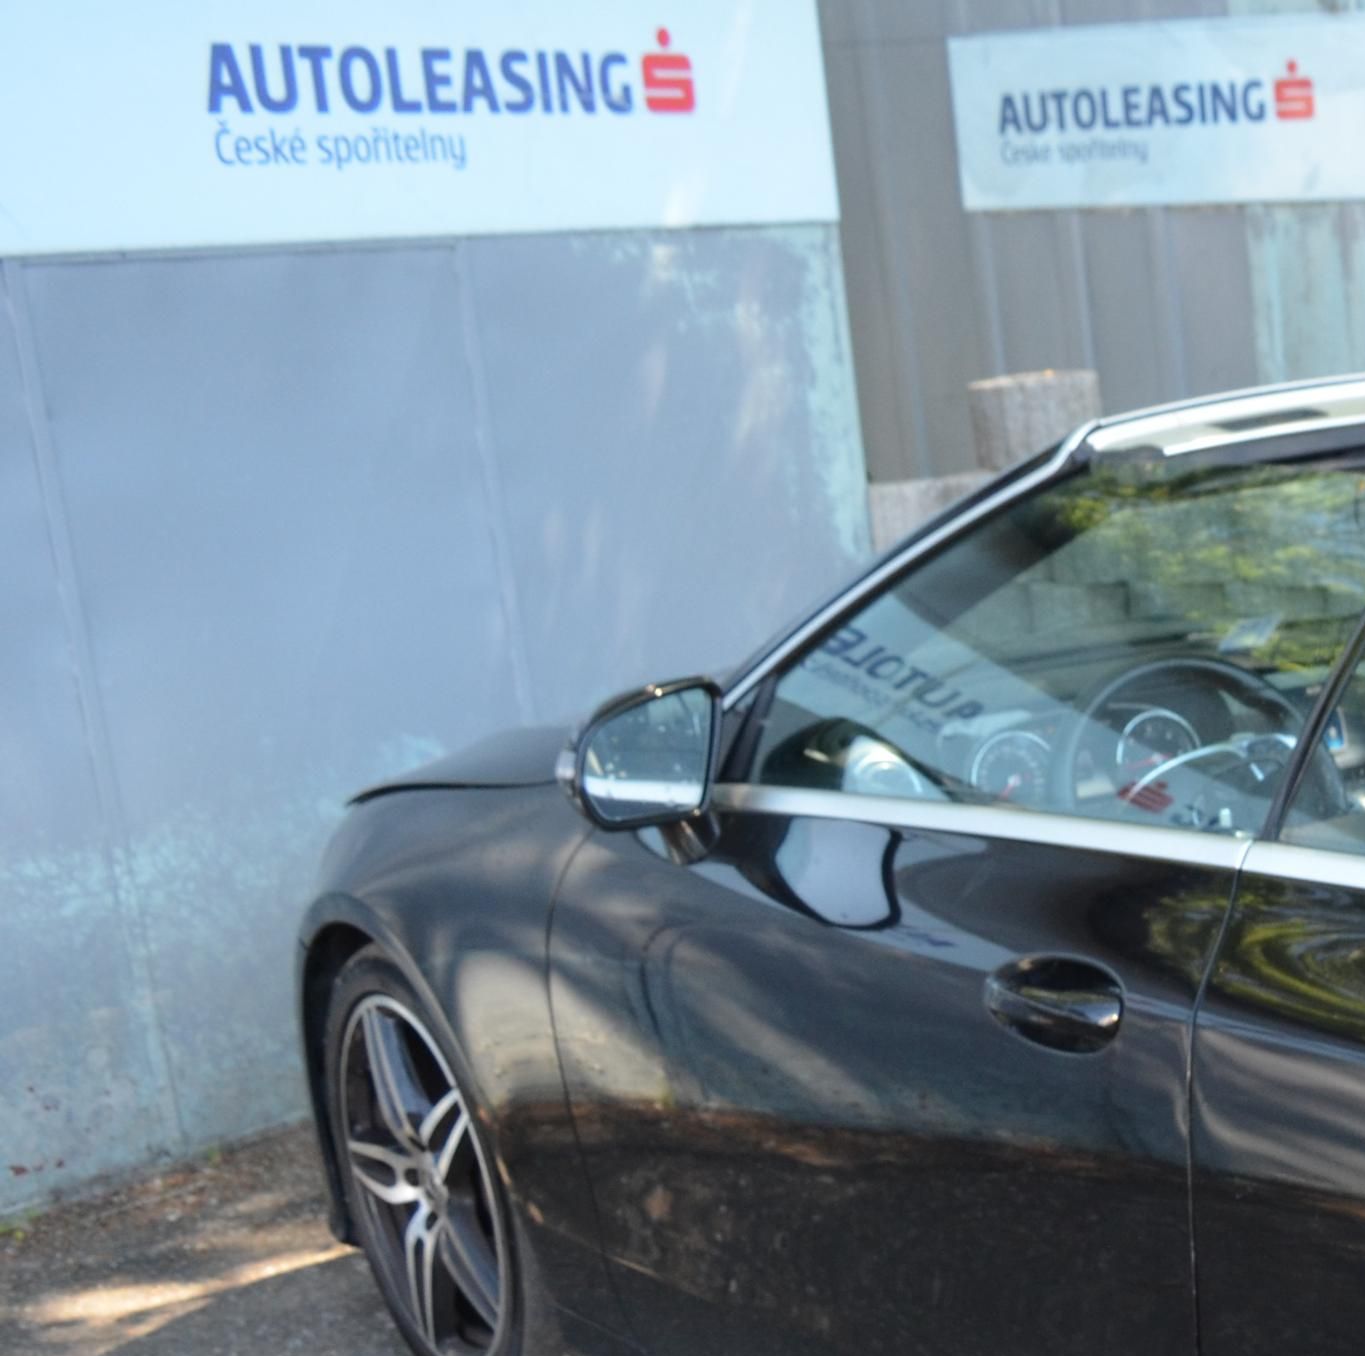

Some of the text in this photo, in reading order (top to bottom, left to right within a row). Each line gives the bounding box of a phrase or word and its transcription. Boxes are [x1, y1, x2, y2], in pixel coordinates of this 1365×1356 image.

[207, 43, 635, 114] AUTOLEASING
[998, 79, 1267, 135] AUTOLEASING
[214, 121, 468, 171] České spořitelny
